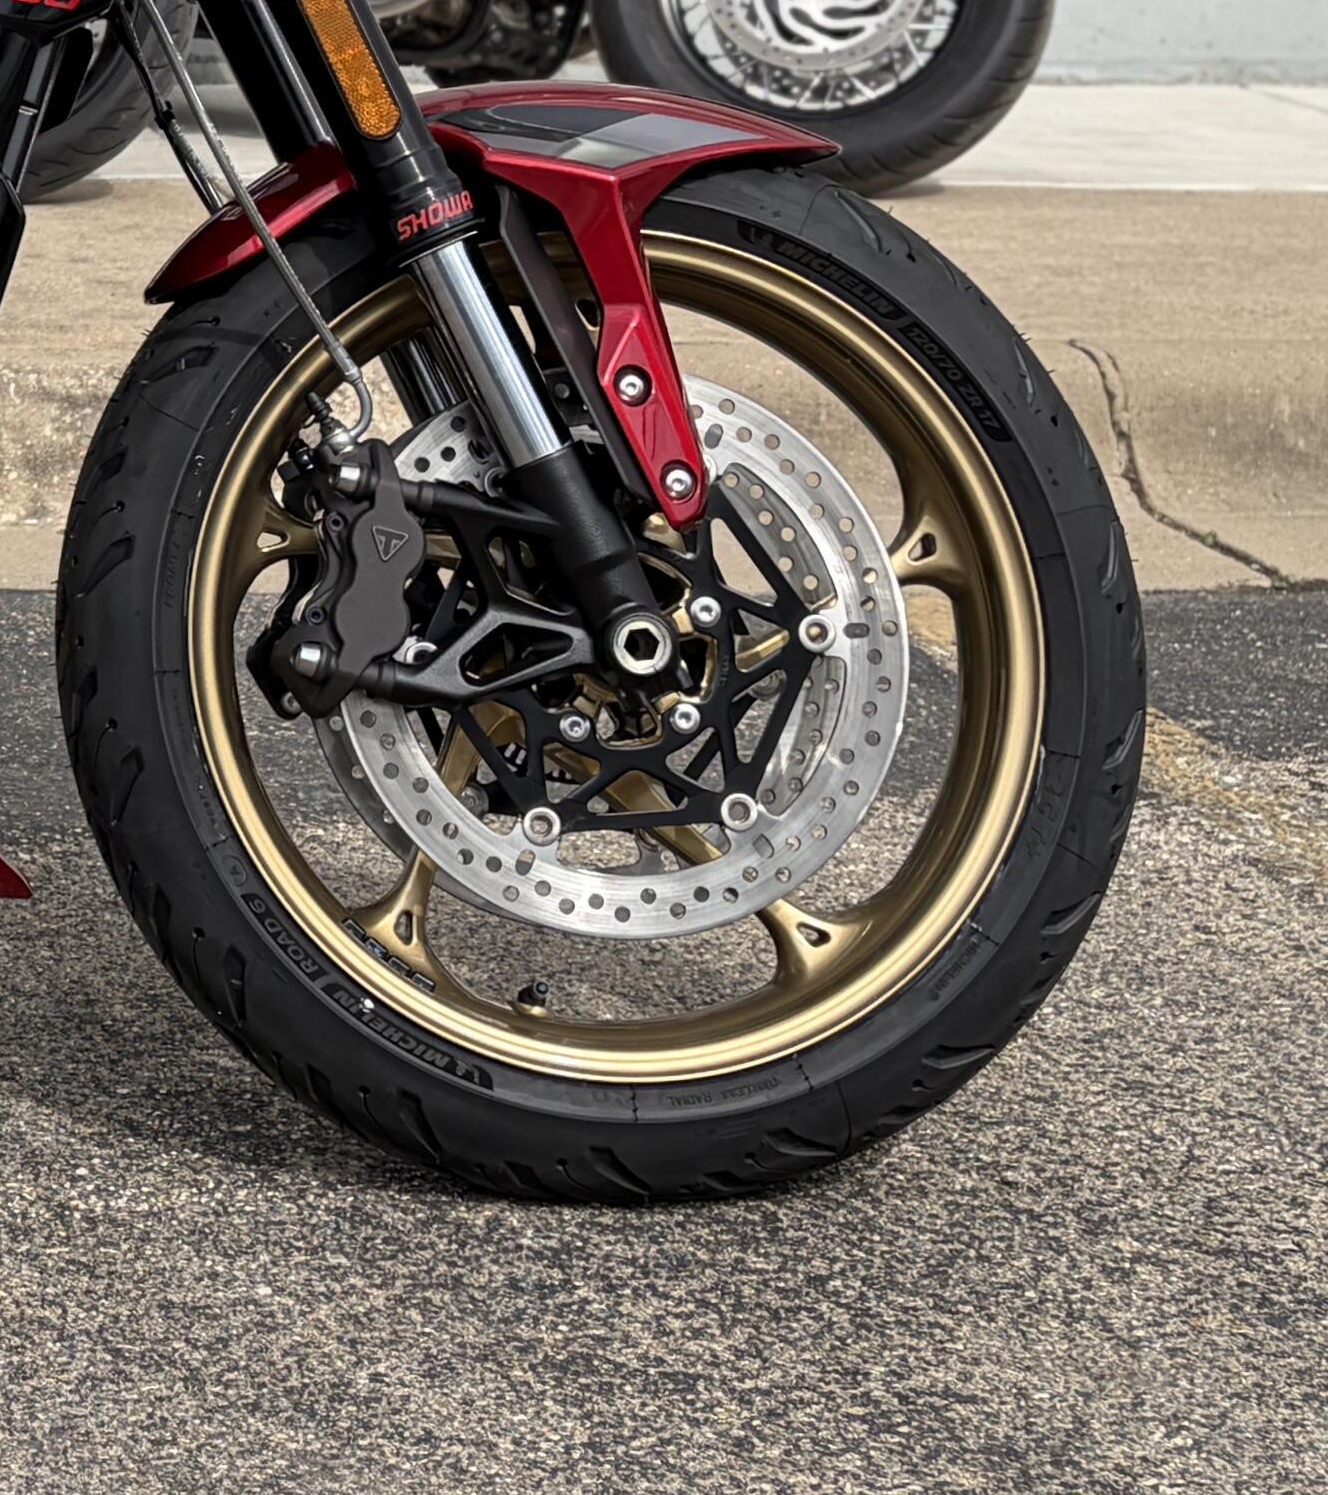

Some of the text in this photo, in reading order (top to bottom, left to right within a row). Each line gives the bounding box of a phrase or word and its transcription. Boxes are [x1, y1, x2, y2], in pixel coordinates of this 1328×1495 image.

[397, 190, 473, 243] SHOWA
[776, 238, 892, 316] MICHELIN
[907, 325, 1002, 431] 120/70 ZR 17
[249, 898, 320, 974] ROAD 6
[333, 990, 450, 1069] MICHELIN
